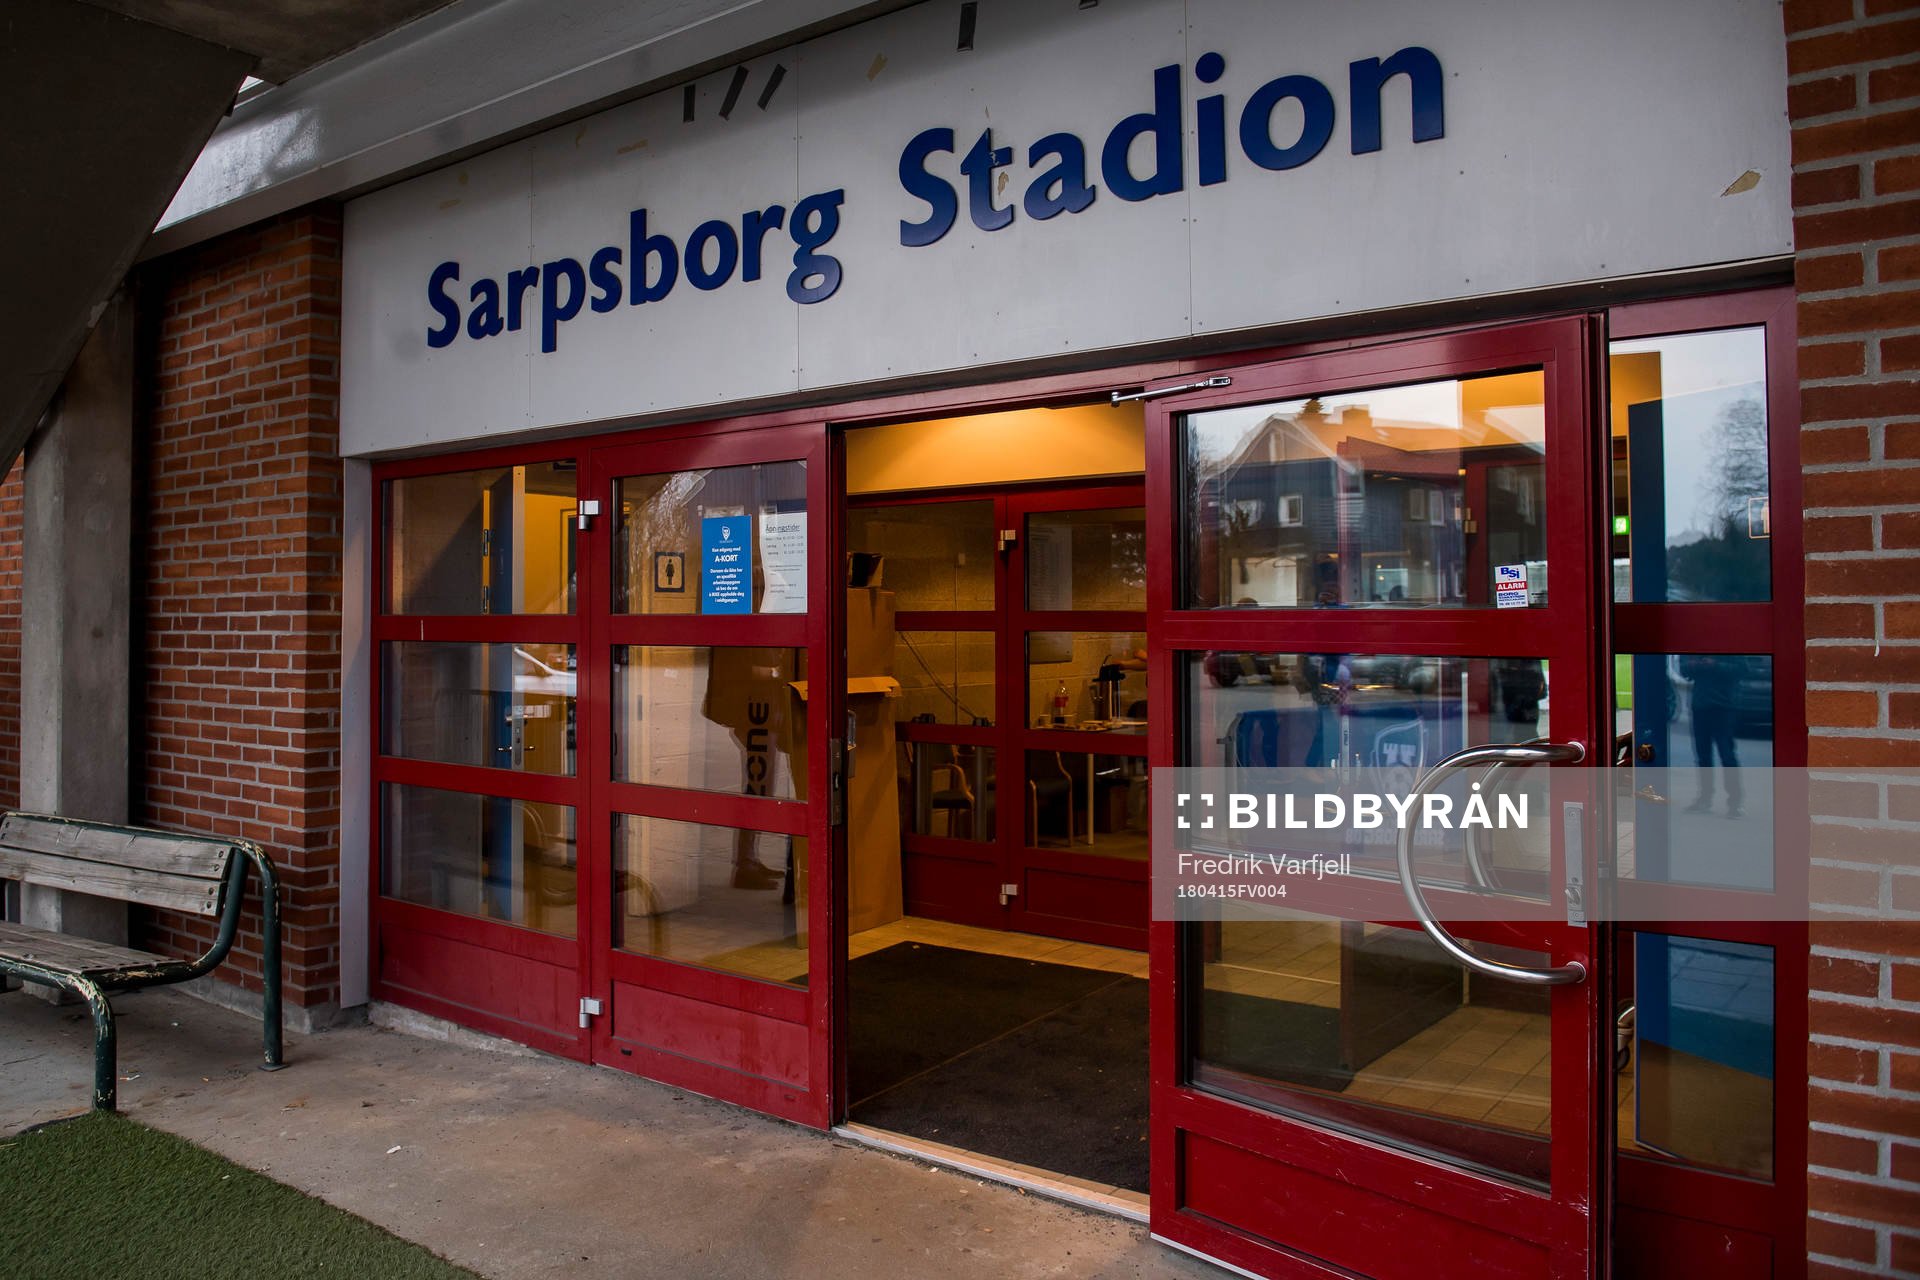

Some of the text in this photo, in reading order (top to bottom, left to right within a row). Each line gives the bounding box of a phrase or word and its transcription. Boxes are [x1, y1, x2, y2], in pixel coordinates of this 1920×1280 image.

[427, 46, 1446, 353] Sarpsborg Stadion
[714, 554, 738, 562] A-KORT
[1497, 582, 1525, 590] ALARM
